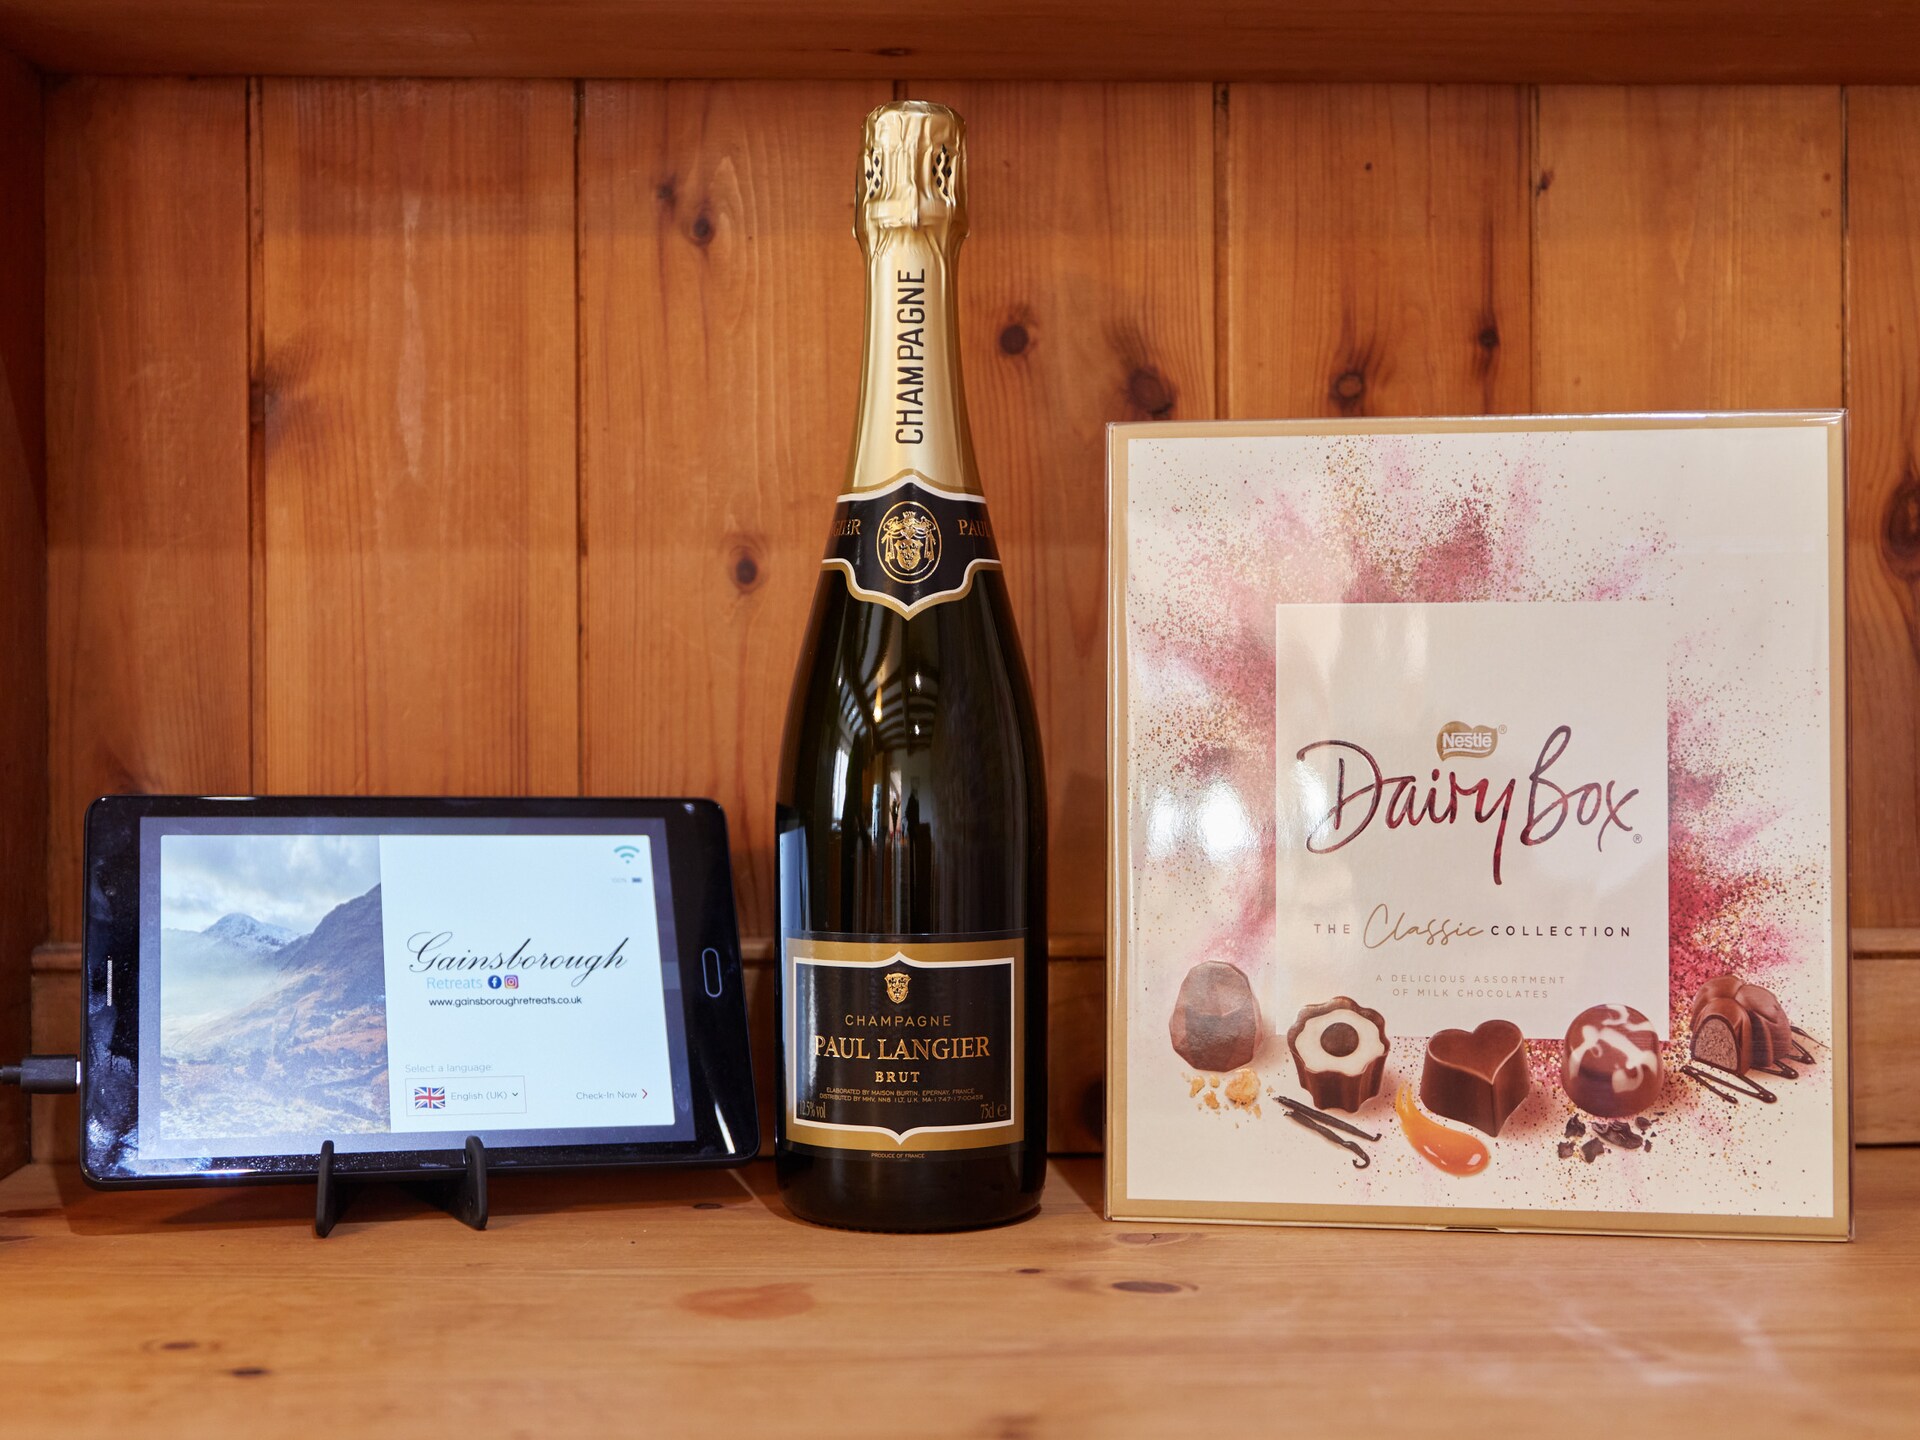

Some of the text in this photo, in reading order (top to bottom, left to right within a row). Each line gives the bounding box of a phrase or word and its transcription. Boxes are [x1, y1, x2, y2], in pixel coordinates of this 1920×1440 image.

[895, 268, 925, 444] CHAMPAGNE
[1296, 725, 1639, 886] Dairy Box
[1313, 904, 1631, 949] THE Classic COLLECTION
[407, 931, 630, 988] Gainsborough
[427, 977, 483, 990] Retreats
[1375, 974, 1566, 985] A DELICIOUS ASSORTMENT
[1392, 988, 1549, 999] OF MILK CHOCOLATES
[429, 995, 582, 1008] www.gainsboroughretreats.co.uk
[845, 1014, 952, 1028] CHAMPAGNE
[815, 1035, 991, 1060] PAUL LANGIER
[405, 1063, 435, 1073] Select
[875, 1071, 920, 1083] BRUT
[451, 1090, 508, 1102] English (UK)
[575, 1090, 638, 1100] Check-In Now
